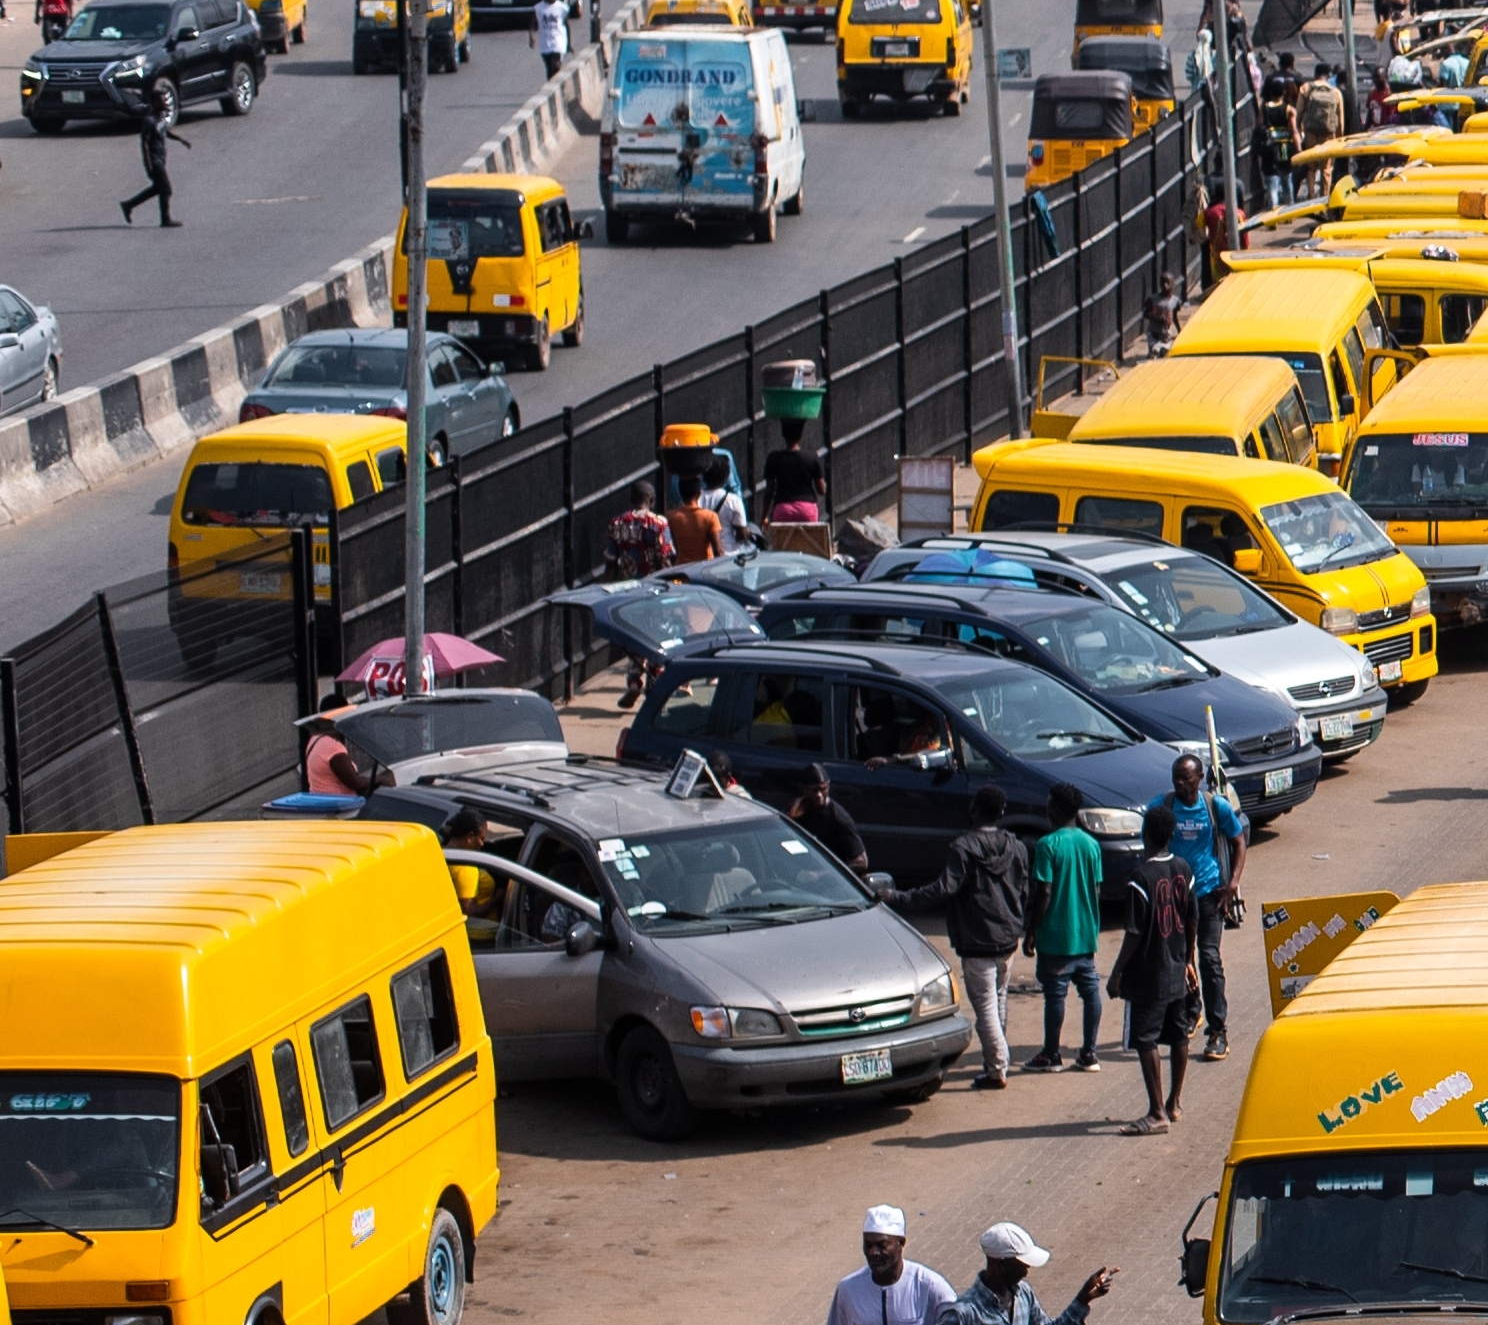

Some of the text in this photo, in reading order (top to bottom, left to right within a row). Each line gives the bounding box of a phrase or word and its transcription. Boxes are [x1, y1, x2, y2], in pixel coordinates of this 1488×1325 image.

[625, 68, 737, 85] GONDRAND
[1412, 433, 1469, 446] JESUS
[1317, 1068, 1404, 1135] LOVE
